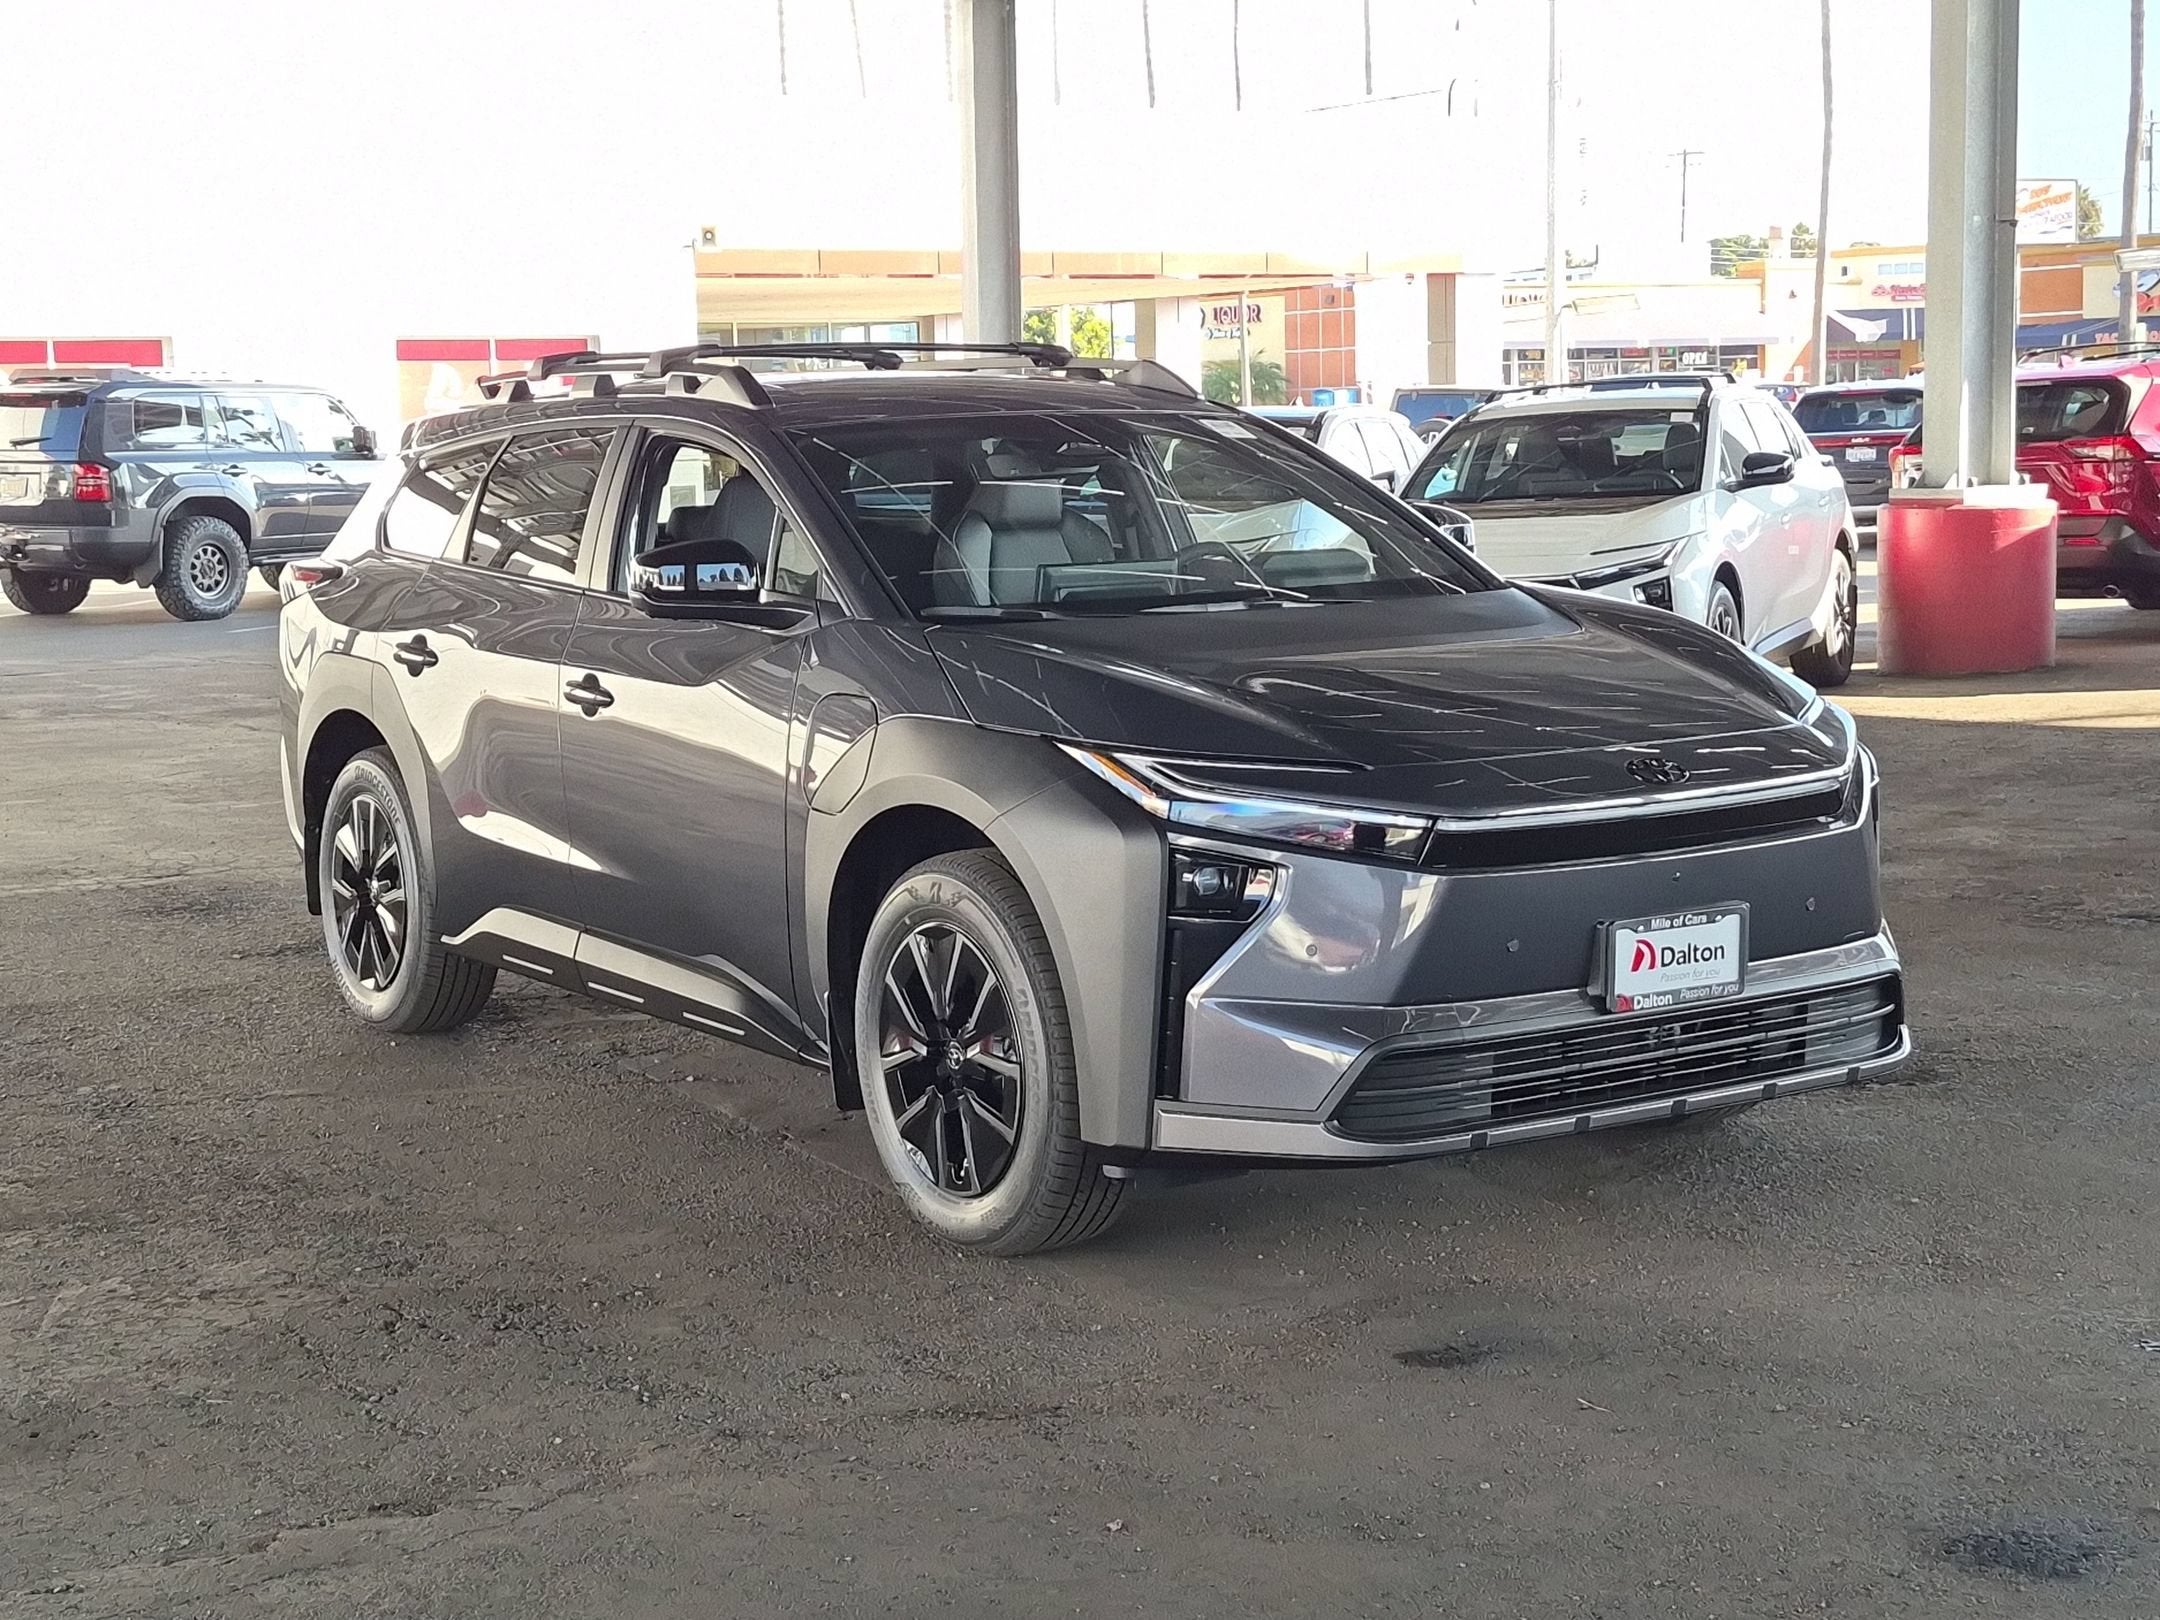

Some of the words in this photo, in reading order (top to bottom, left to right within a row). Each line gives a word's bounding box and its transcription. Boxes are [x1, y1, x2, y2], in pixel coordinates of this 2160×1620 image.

[1651, 918, 1671, 930] Mile
[1672, 915, 1684, 927] of
[1685, 914, 1707, 925] Cars
[1661, 943, 1725, 968] Dalton
[1660, 971, 1690, 982] Passion
[1692, 968, 1705, 979] for
[1706, 968, 1721, 979] you
[1634, 994, 1672, 1010] Dalton
[1680, 986, 1709, 999] Passion
[1710, 984, 1723, 995] for
[1723, 983, 1739, 995] you
